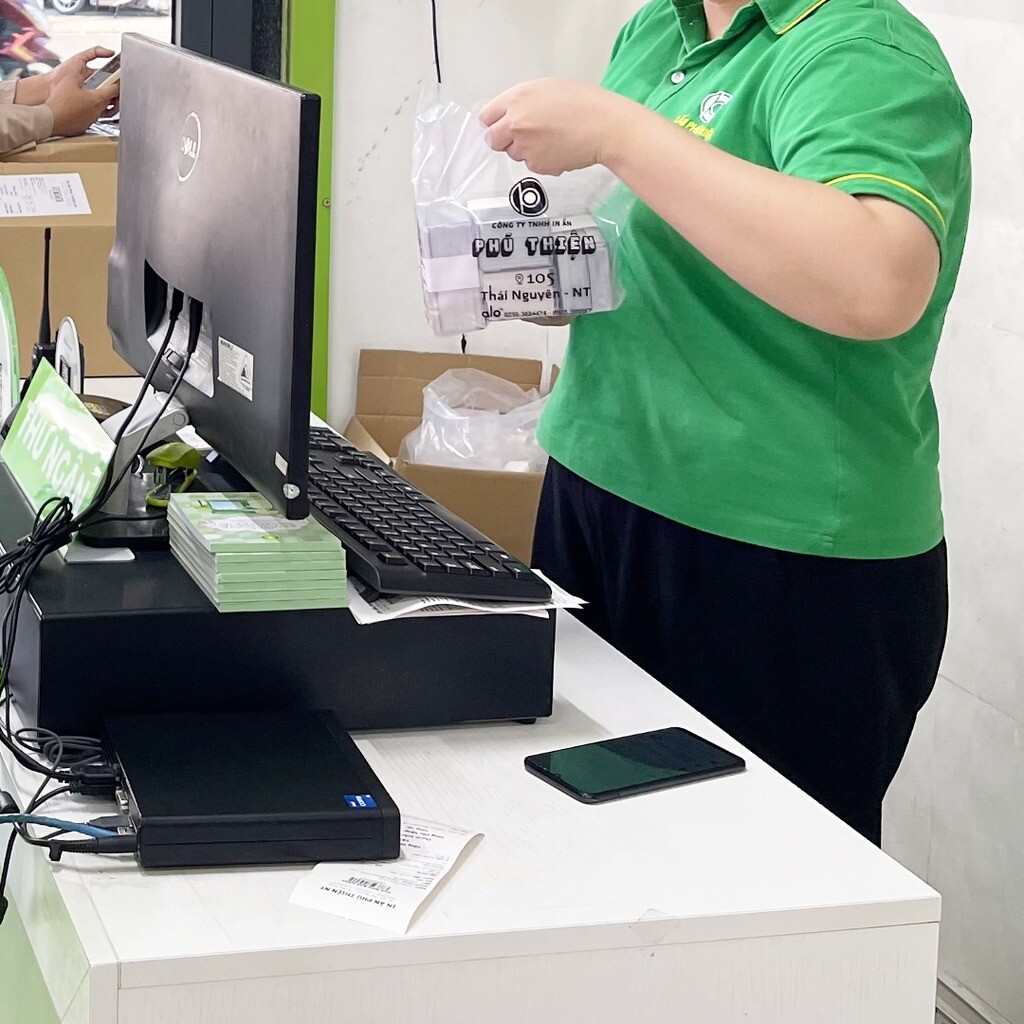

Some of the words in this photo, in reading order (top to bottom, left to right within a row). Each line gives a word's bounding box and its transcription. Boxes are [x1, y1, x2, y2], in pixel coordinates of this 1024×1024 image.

[491, 221, 514, 229] CÔNG
[528, 220, 550, 228] TNHH
[562, 218, 572, 227] ẤN
[525, 229, 597, 261] THIỆN
[526, 273, 555, 287] 105
[481, 285, 508, 302] Thái
[512, 287, 560, 304] Nguyên
[572, 287, 591, 297] NT
